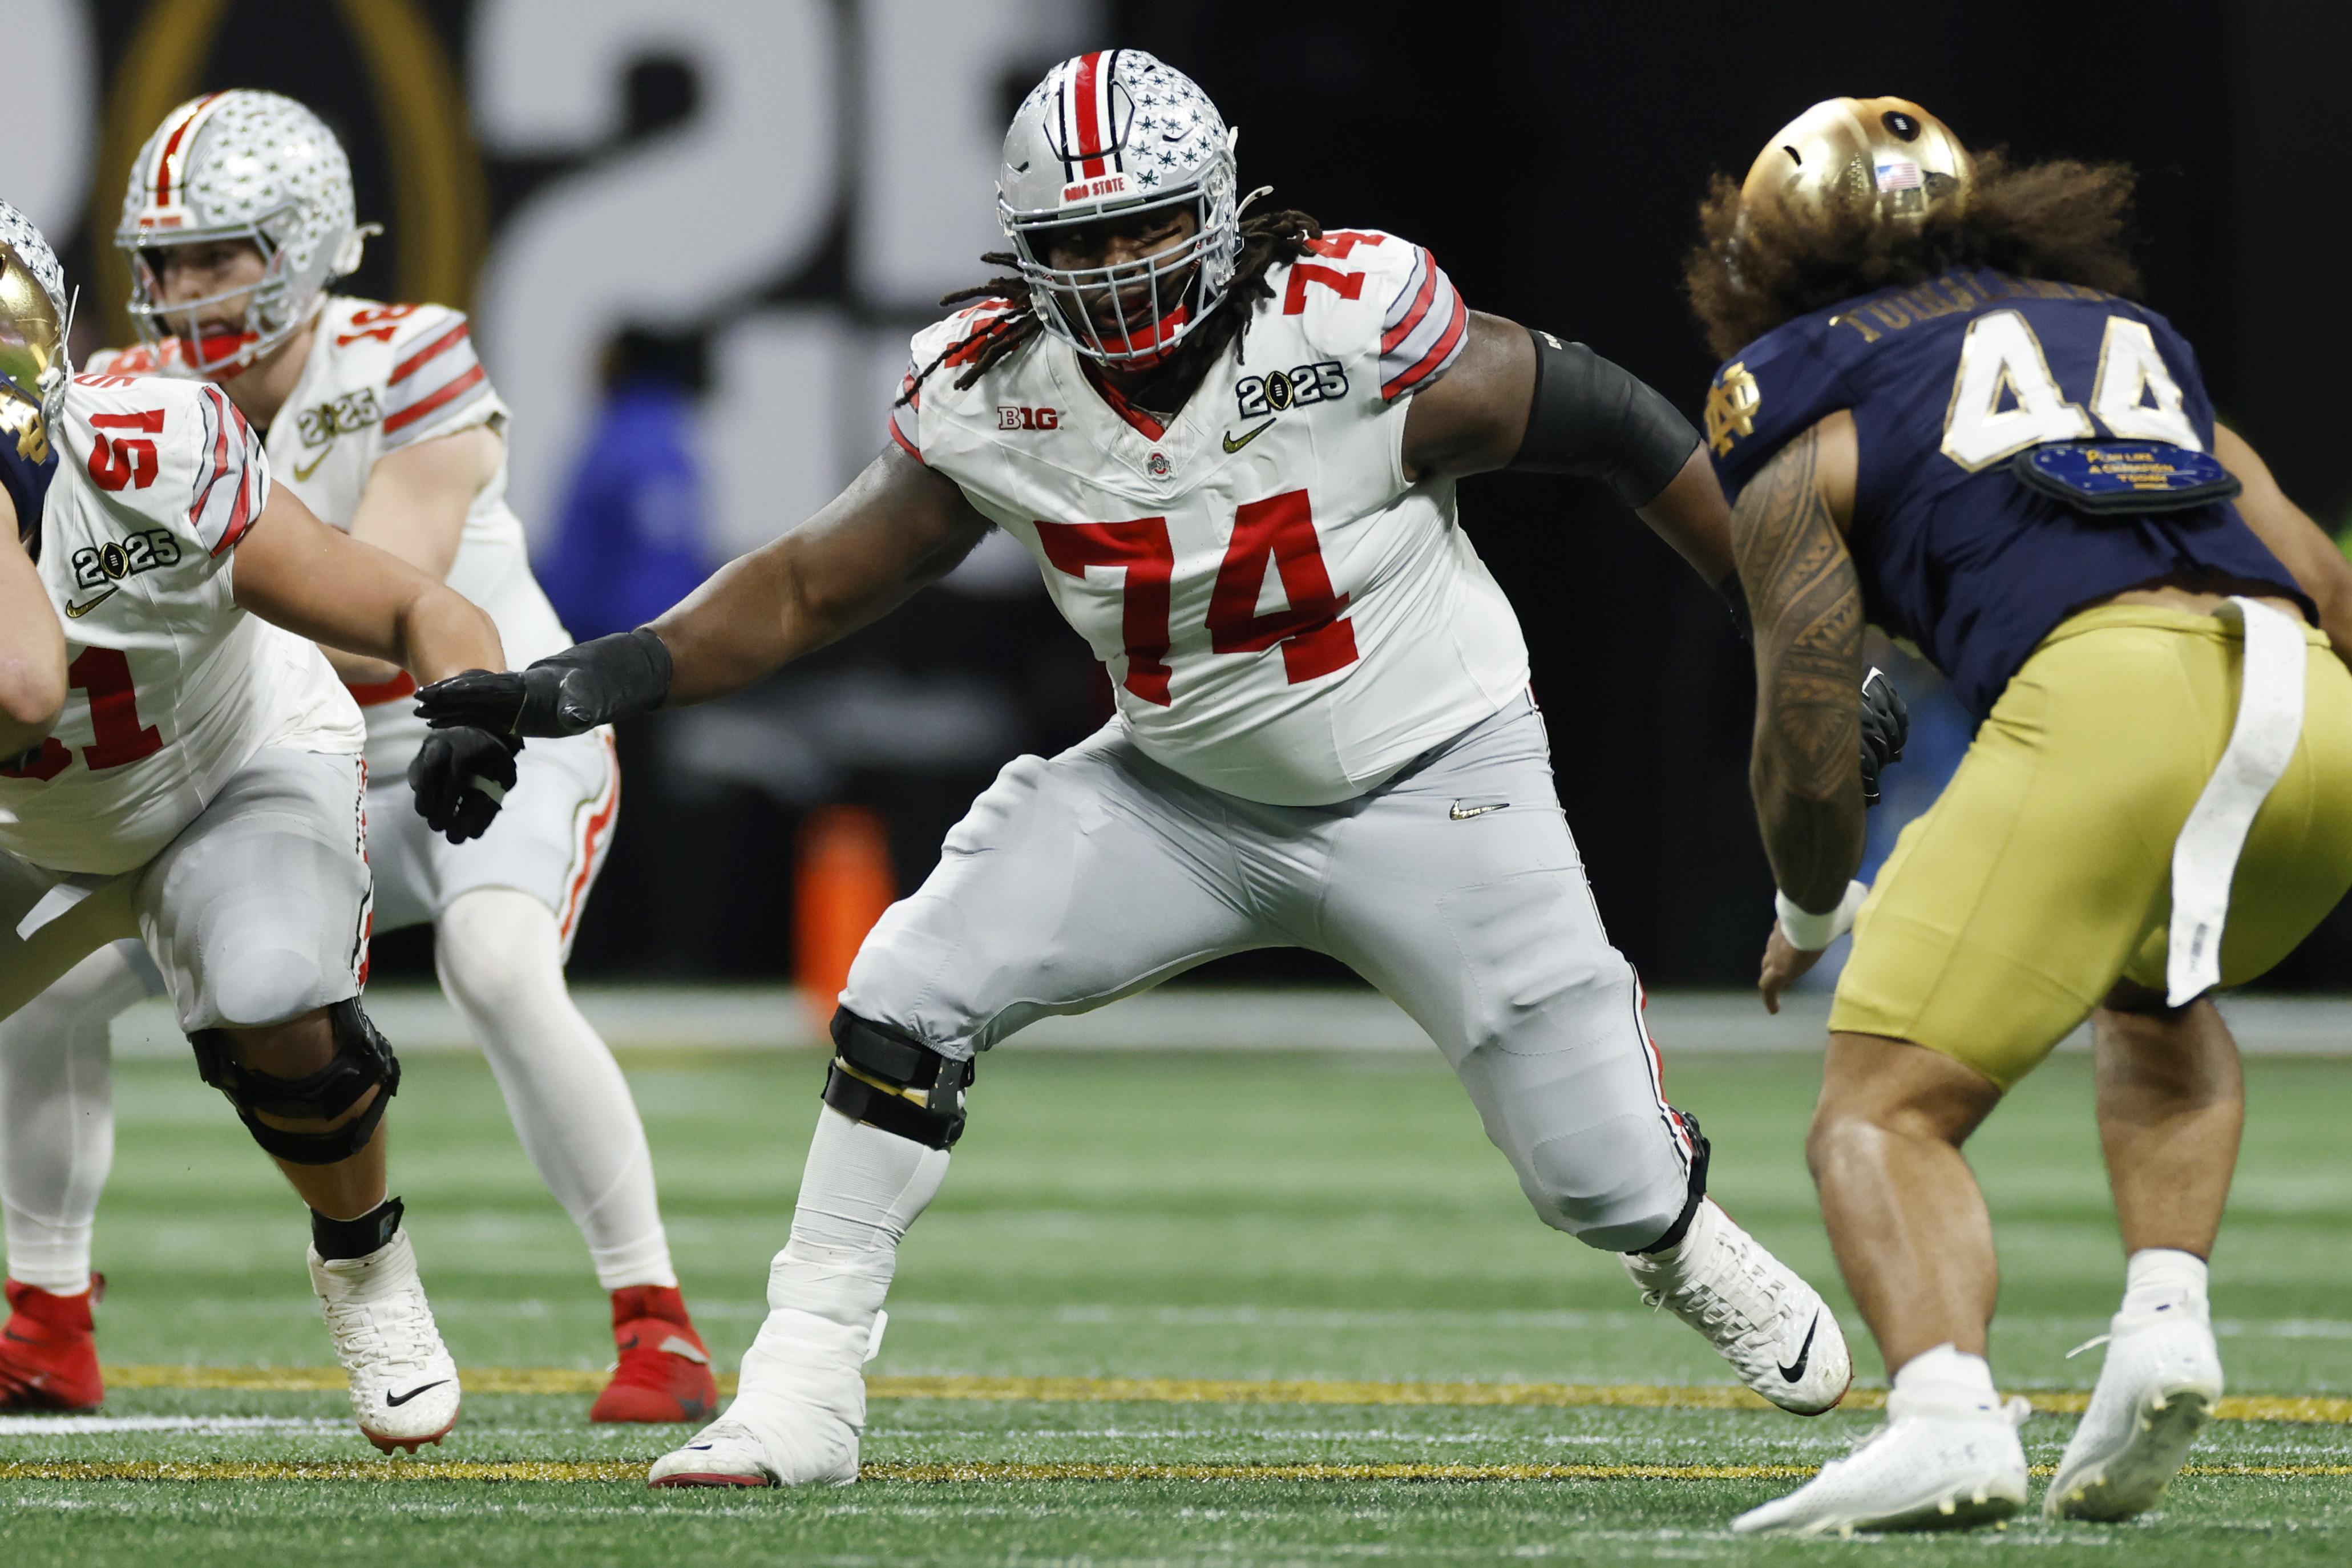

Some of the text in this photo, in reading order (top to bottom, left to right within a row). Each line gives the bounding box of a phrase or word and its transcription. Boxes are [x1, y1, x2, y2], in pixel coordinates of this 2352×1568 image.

[1092, 177, 1125, 196] STATE
[1282, 231, 1388, 315] 74
[1940, 308, 2204, 473] 44
[87, 409, 165, 491] 51
[1033, 488, 1360, 708] 74
